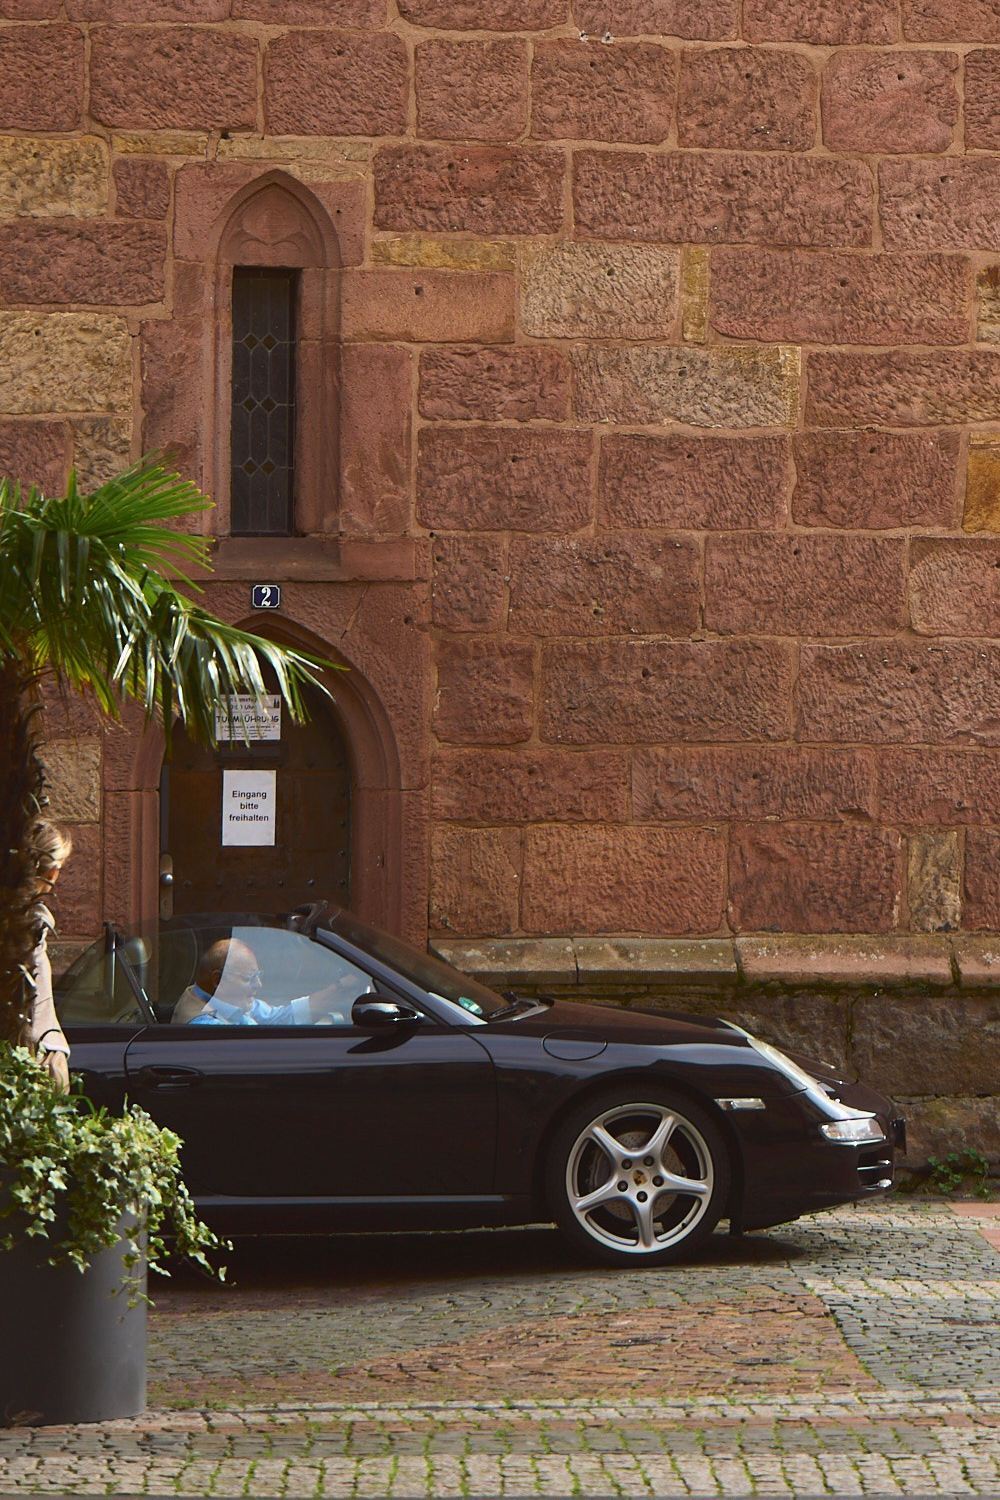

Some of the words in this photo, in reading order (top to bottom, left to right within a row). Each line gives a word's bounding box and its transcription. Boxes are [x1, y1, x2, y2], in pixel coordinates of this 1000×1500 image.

[261, 586, 271, 607] 2
[231, 790, 267, 800] Eingang
[240, 802, 259, 810] bitte
[229, 813, 269, 822] freihalten
